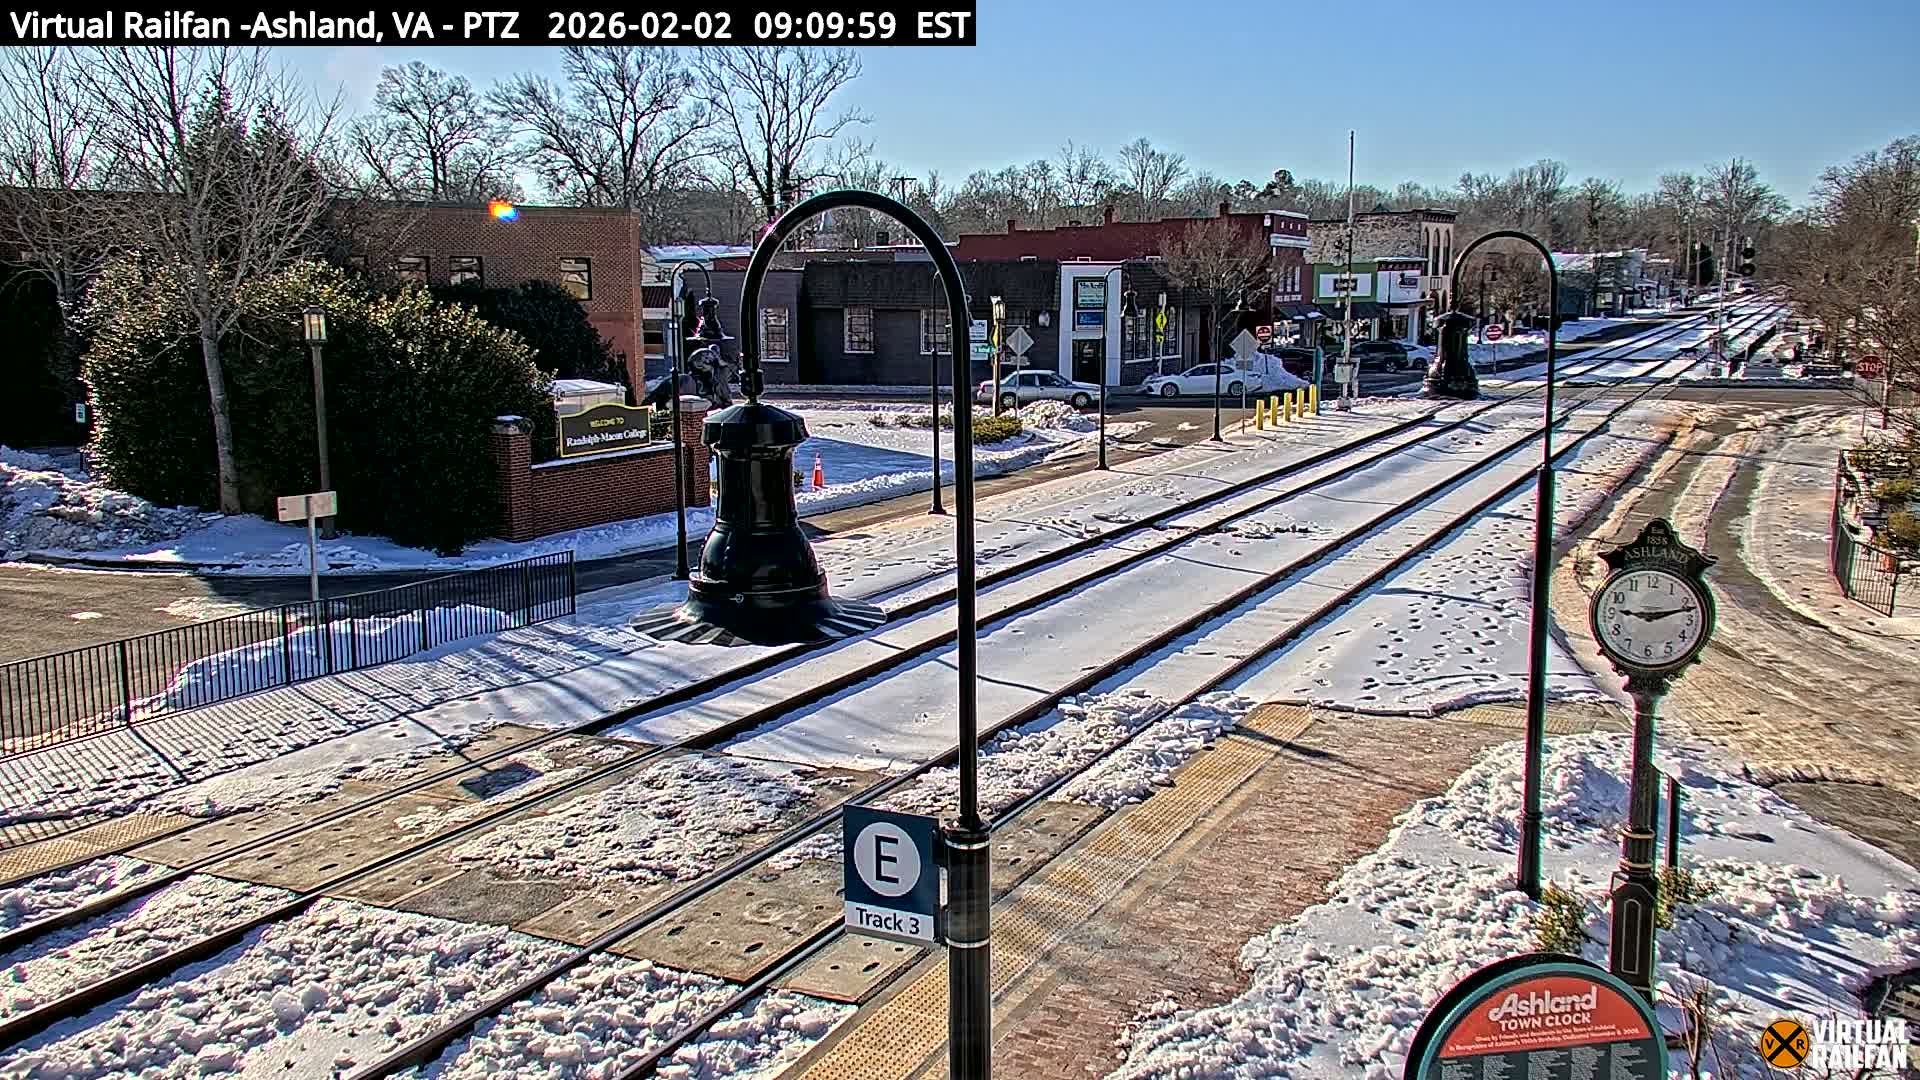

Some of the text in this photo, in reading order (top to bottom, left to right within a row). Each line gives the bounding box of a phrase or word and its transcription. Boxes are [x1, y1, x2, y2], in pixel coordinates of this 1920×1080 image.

[1858, 362, 1883, 372] STOP
[1624, 546, 1689, 564] ASHLAND
[1629, 578, 1639, 592] 11
[1647, 575, 1660, 589] 12
[1668, 582, 1675, 595] 1
[1613, 591, 1625, 604] 10
[1607, 607, 1616, 619] 9
[1685, 614, 1694, 626] 3
[1611, 623, 1622, 636] 8
[1678, 629, 1688, 642] 4
[1624, 638, 1633, 650] 7
[1644, 644, 1652, 657] 6
[1664, 641, 1673, 657] 5
[874, 834, 900, 884] E
[855, 907, 920, 935] Track 3
[1488, 985, 1598, 1021] Ashland
[1499, 1012, 1591, 1031] TOWN CLOCK
